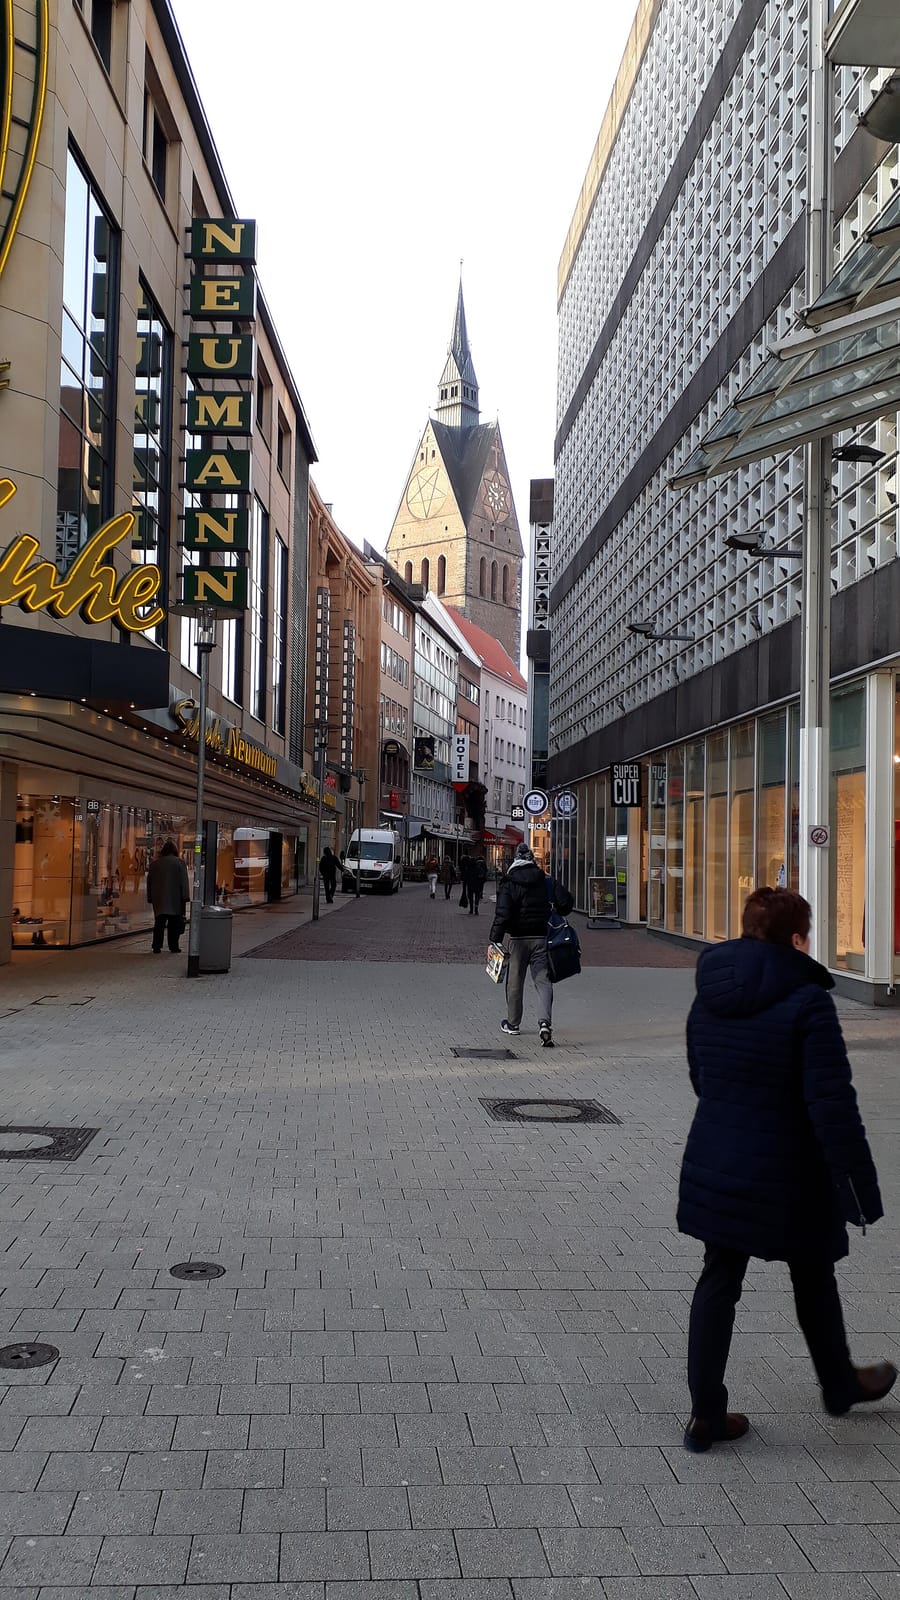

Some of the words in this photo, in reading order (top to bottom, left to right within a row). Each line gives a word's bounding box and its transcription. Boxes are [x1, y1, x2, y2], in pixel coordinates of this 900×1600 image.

[194, 223, 246, 602] NEUMANN
[0, 478, 166, 632] uhe
[226, 726, 278, 778] Neumann
[456, 737, 466, 779] HOTEL
[613, 764, 639, 778] SUPER
[613, 778, 640, 804] CUT
